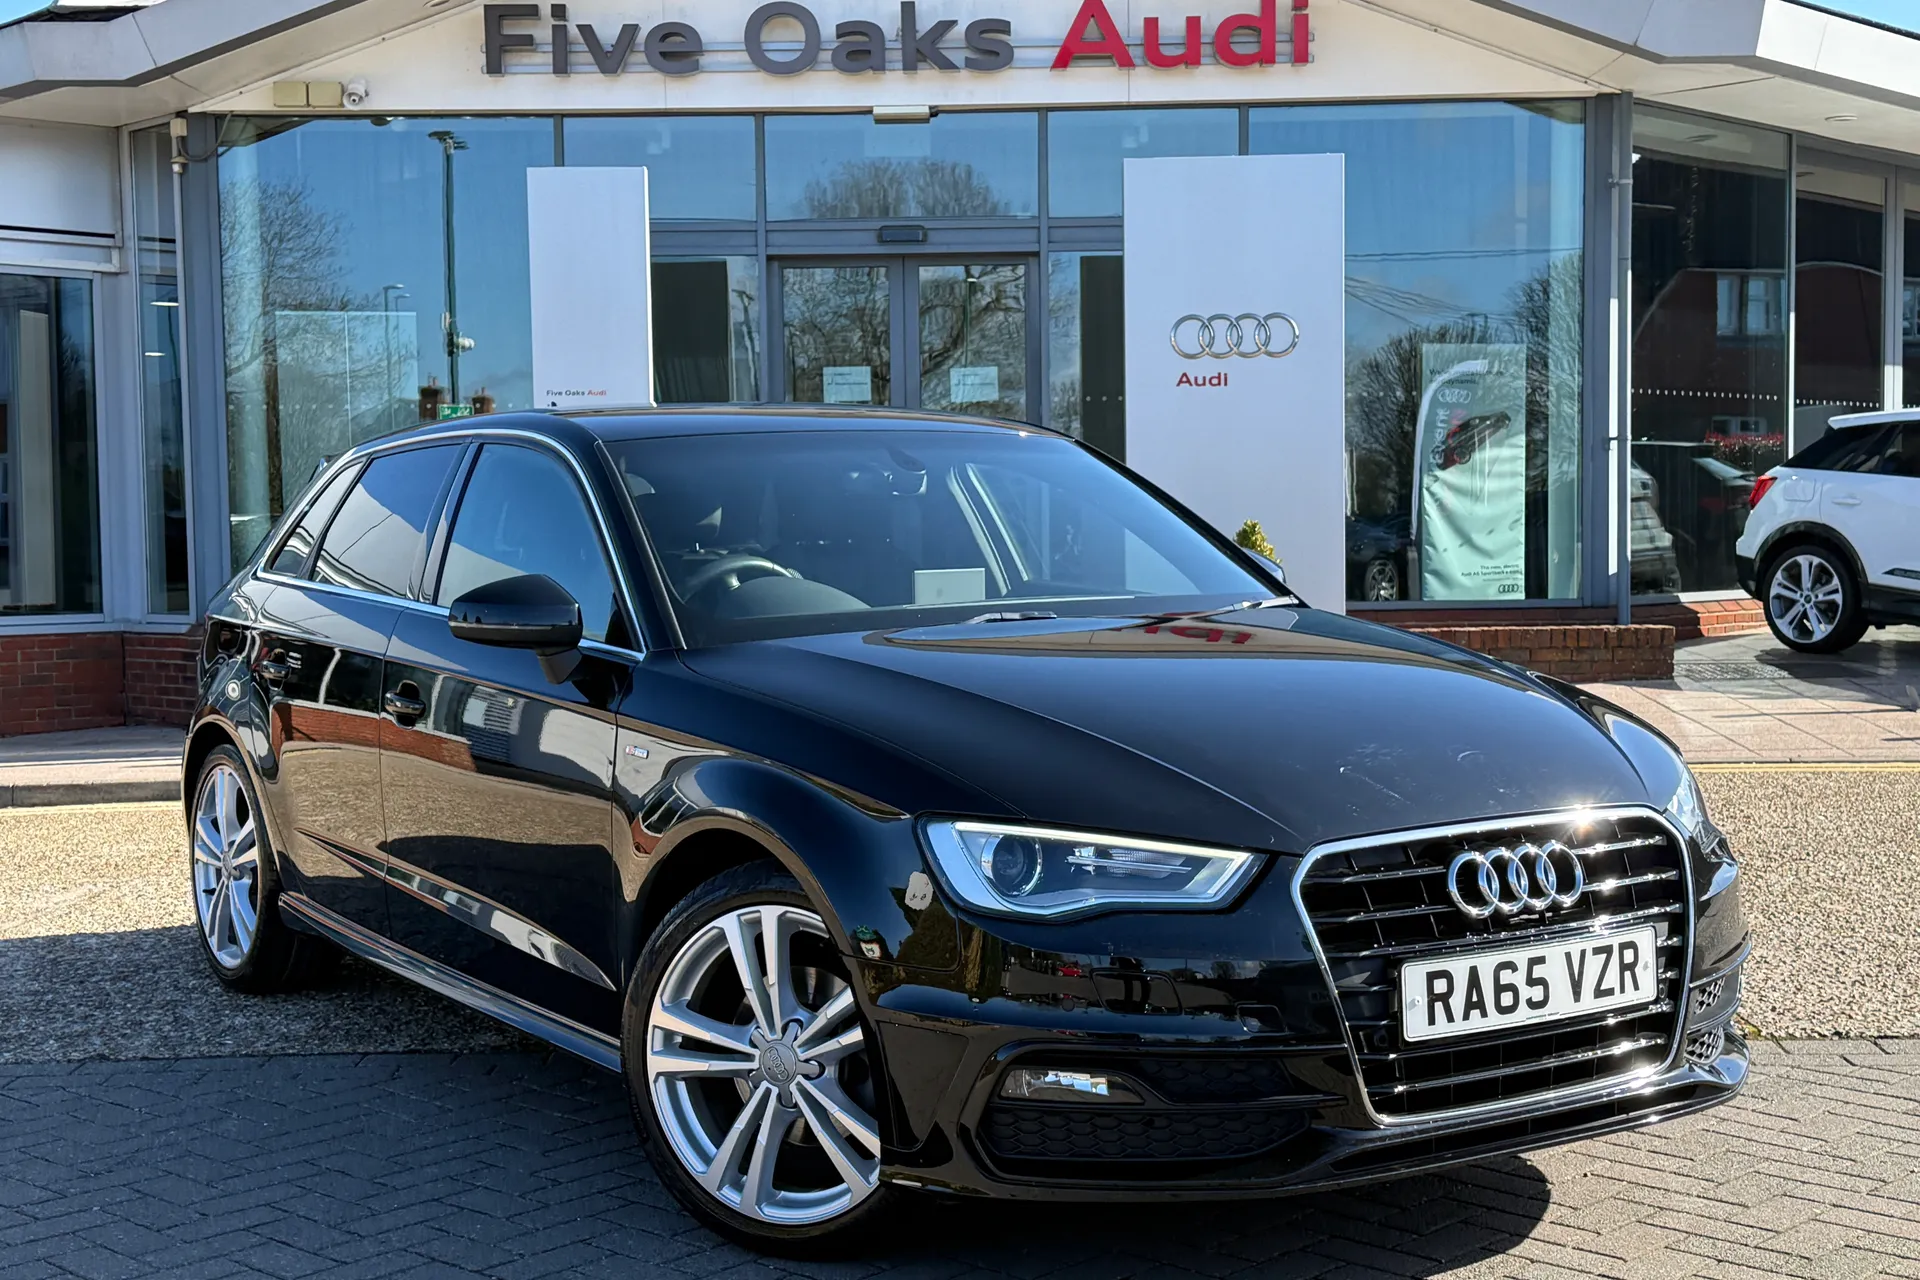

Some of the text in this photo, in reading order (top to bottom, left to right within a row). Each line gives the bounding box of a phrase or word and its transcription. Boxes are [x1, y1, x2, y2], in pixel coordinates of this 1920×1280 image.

[484, 0, 1310, 76] Five Oaks Audi
[1176, 371, 1229, 387] Audi
[1425, 940, 1640, 1026] RA65 VZR
